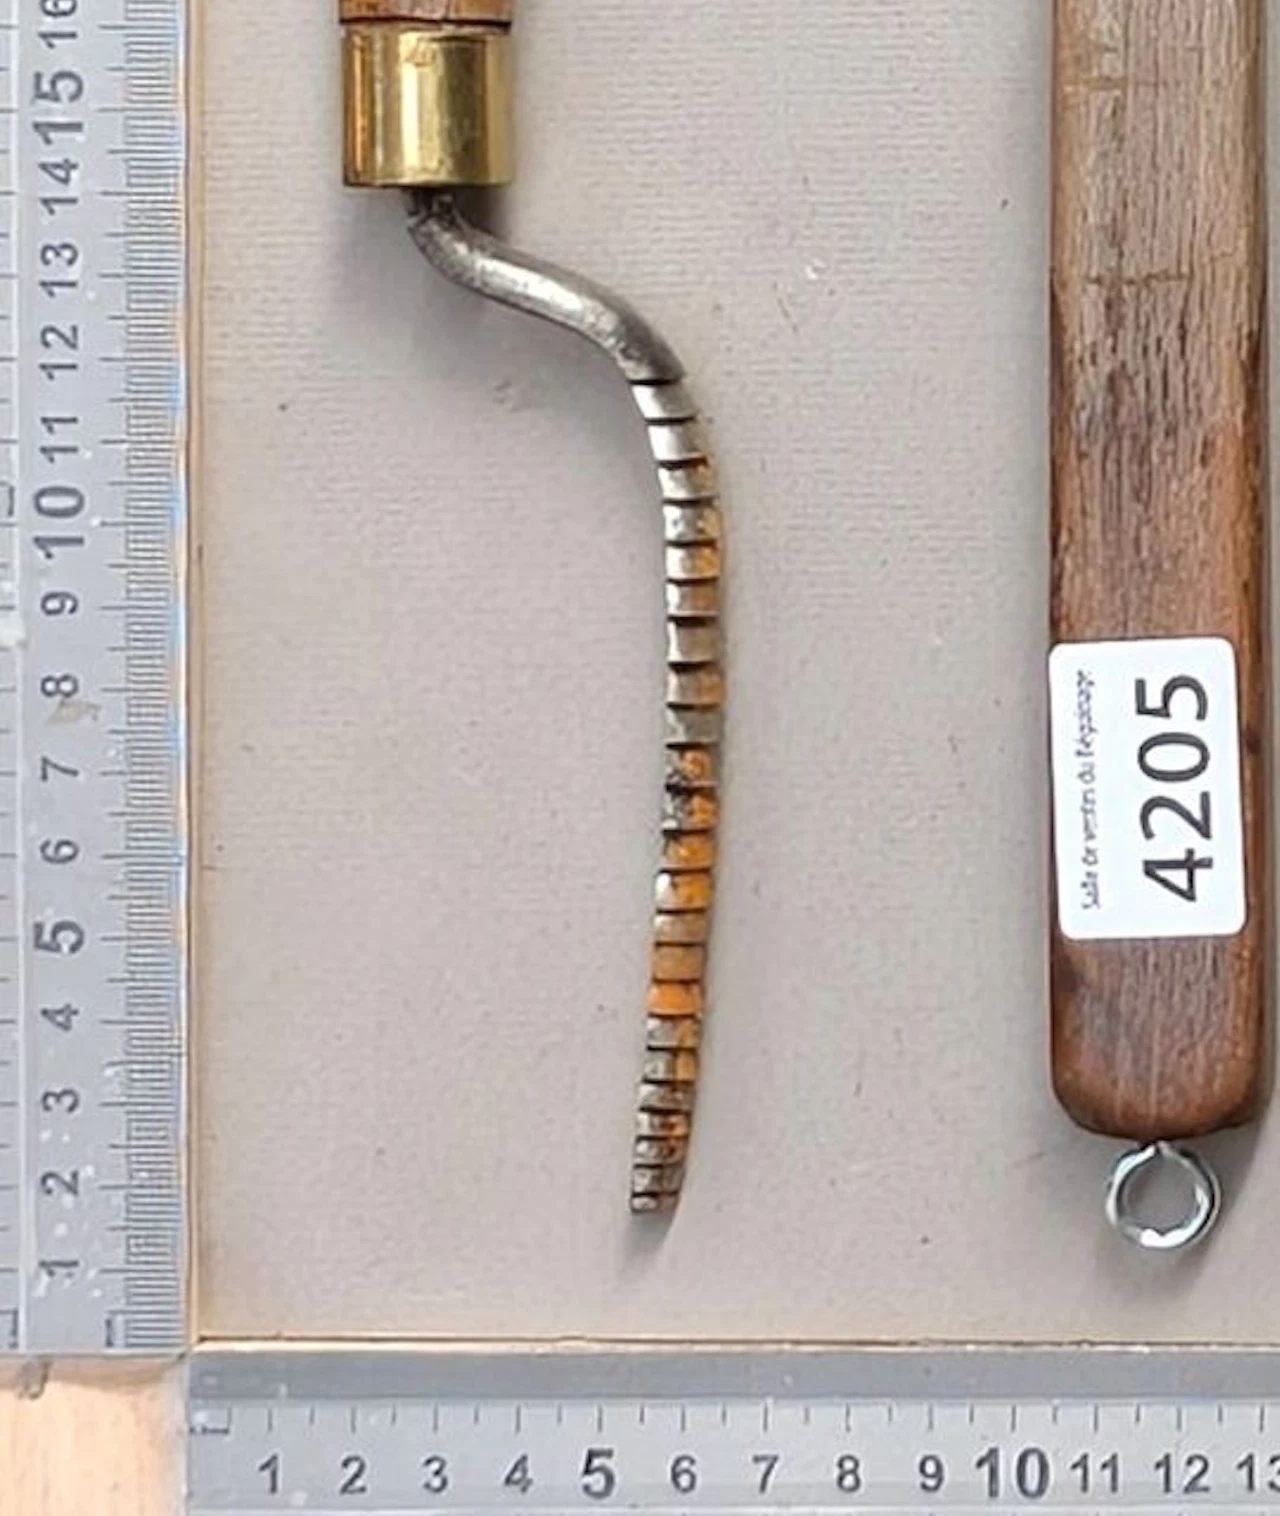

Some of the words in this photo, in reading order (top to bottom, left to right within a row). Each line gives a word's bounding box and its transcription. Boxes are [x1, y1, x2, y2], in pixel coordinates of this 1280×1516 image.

[31, 70, 84, 146] 15
[37, 158, 79, 216] 14
[38, 242, 79, 298] 13
[38, 324, 79, 381] 12
[39, 416, 79, 464] 11
[32, 485, 85, 560] 10
[40, 591, 79, 617] 9
[40, 673, 79, 702] 8
[40, 756, 79, 783] 7
[1134, 673, 1214, 903] 4205
[39, 839, 80, 865] 6
[32, 920, 85, 955] 5
[40, 1003, 79, 1032] 4
[40, 1088, 80, 1114] 3
[39, 1170, 79, 1197] 2
[37, 1259, 80, 1278] 1
[258, 1454, 278, 1495] 1
[339, 1455, 367, 1496] 2
[422, 1455, 449, 1494] 3
[503, 1453, 533, 1494] 4
[581, 1447, 616, 1500] 5
[670, 1454, 697, 1495] 6
[752, 1454, 780, 1494] 7
[836, 1454, 862, 1494] 8
[918, 1454, 945, 1494] 9
[975, 1446, 1050, 1500] 10
[1070, 1452, 1119, 1494] 11
[1153, 1452, 1211, 1495] 12
